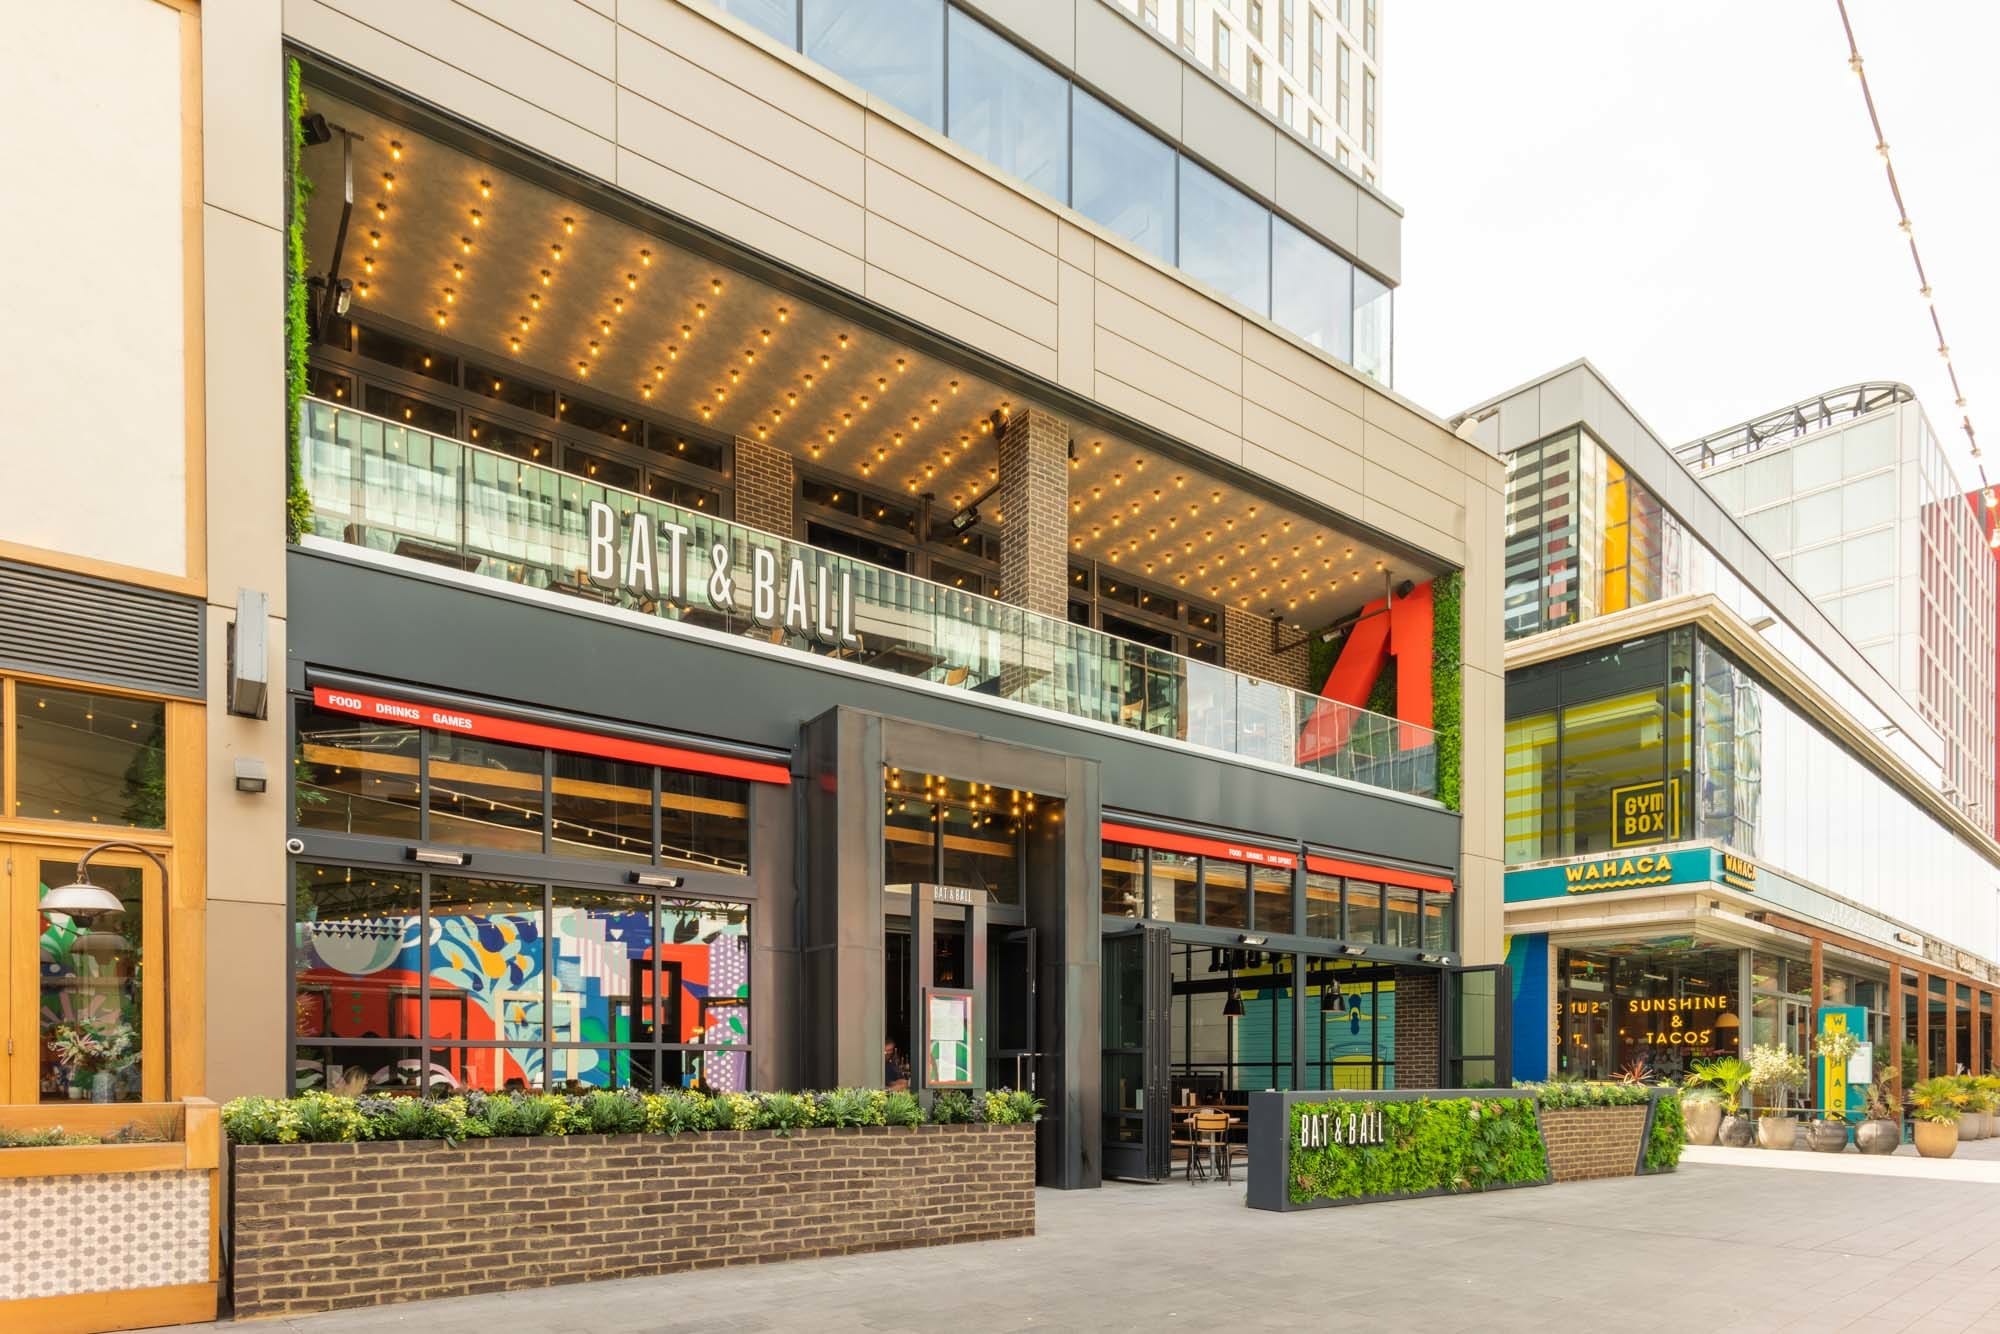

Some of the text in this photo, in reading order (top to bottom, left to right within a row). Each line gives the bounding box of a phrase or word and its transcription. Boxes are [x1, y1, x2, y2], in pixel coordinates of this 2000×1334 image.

[590, 500, 857, 642] BAT & BALL
[328, 695, 473, 729] FOOD DRINKS GAMES
[1624, 793, 1664, 816] GYM
[1624, 812, 1664, 836] BOX
[1565, 855, 1672, 882] WAHACA
[1724, 854, 1757, 881] WAHACA
[1629, 995, 1728, 1013] SUNSHINE
[1671, 1015, 1683, 1028] &
[1646, 1031, 1710, 1045] TACOS
[1301, 1111, 1384, 1148] BAT & BALL
